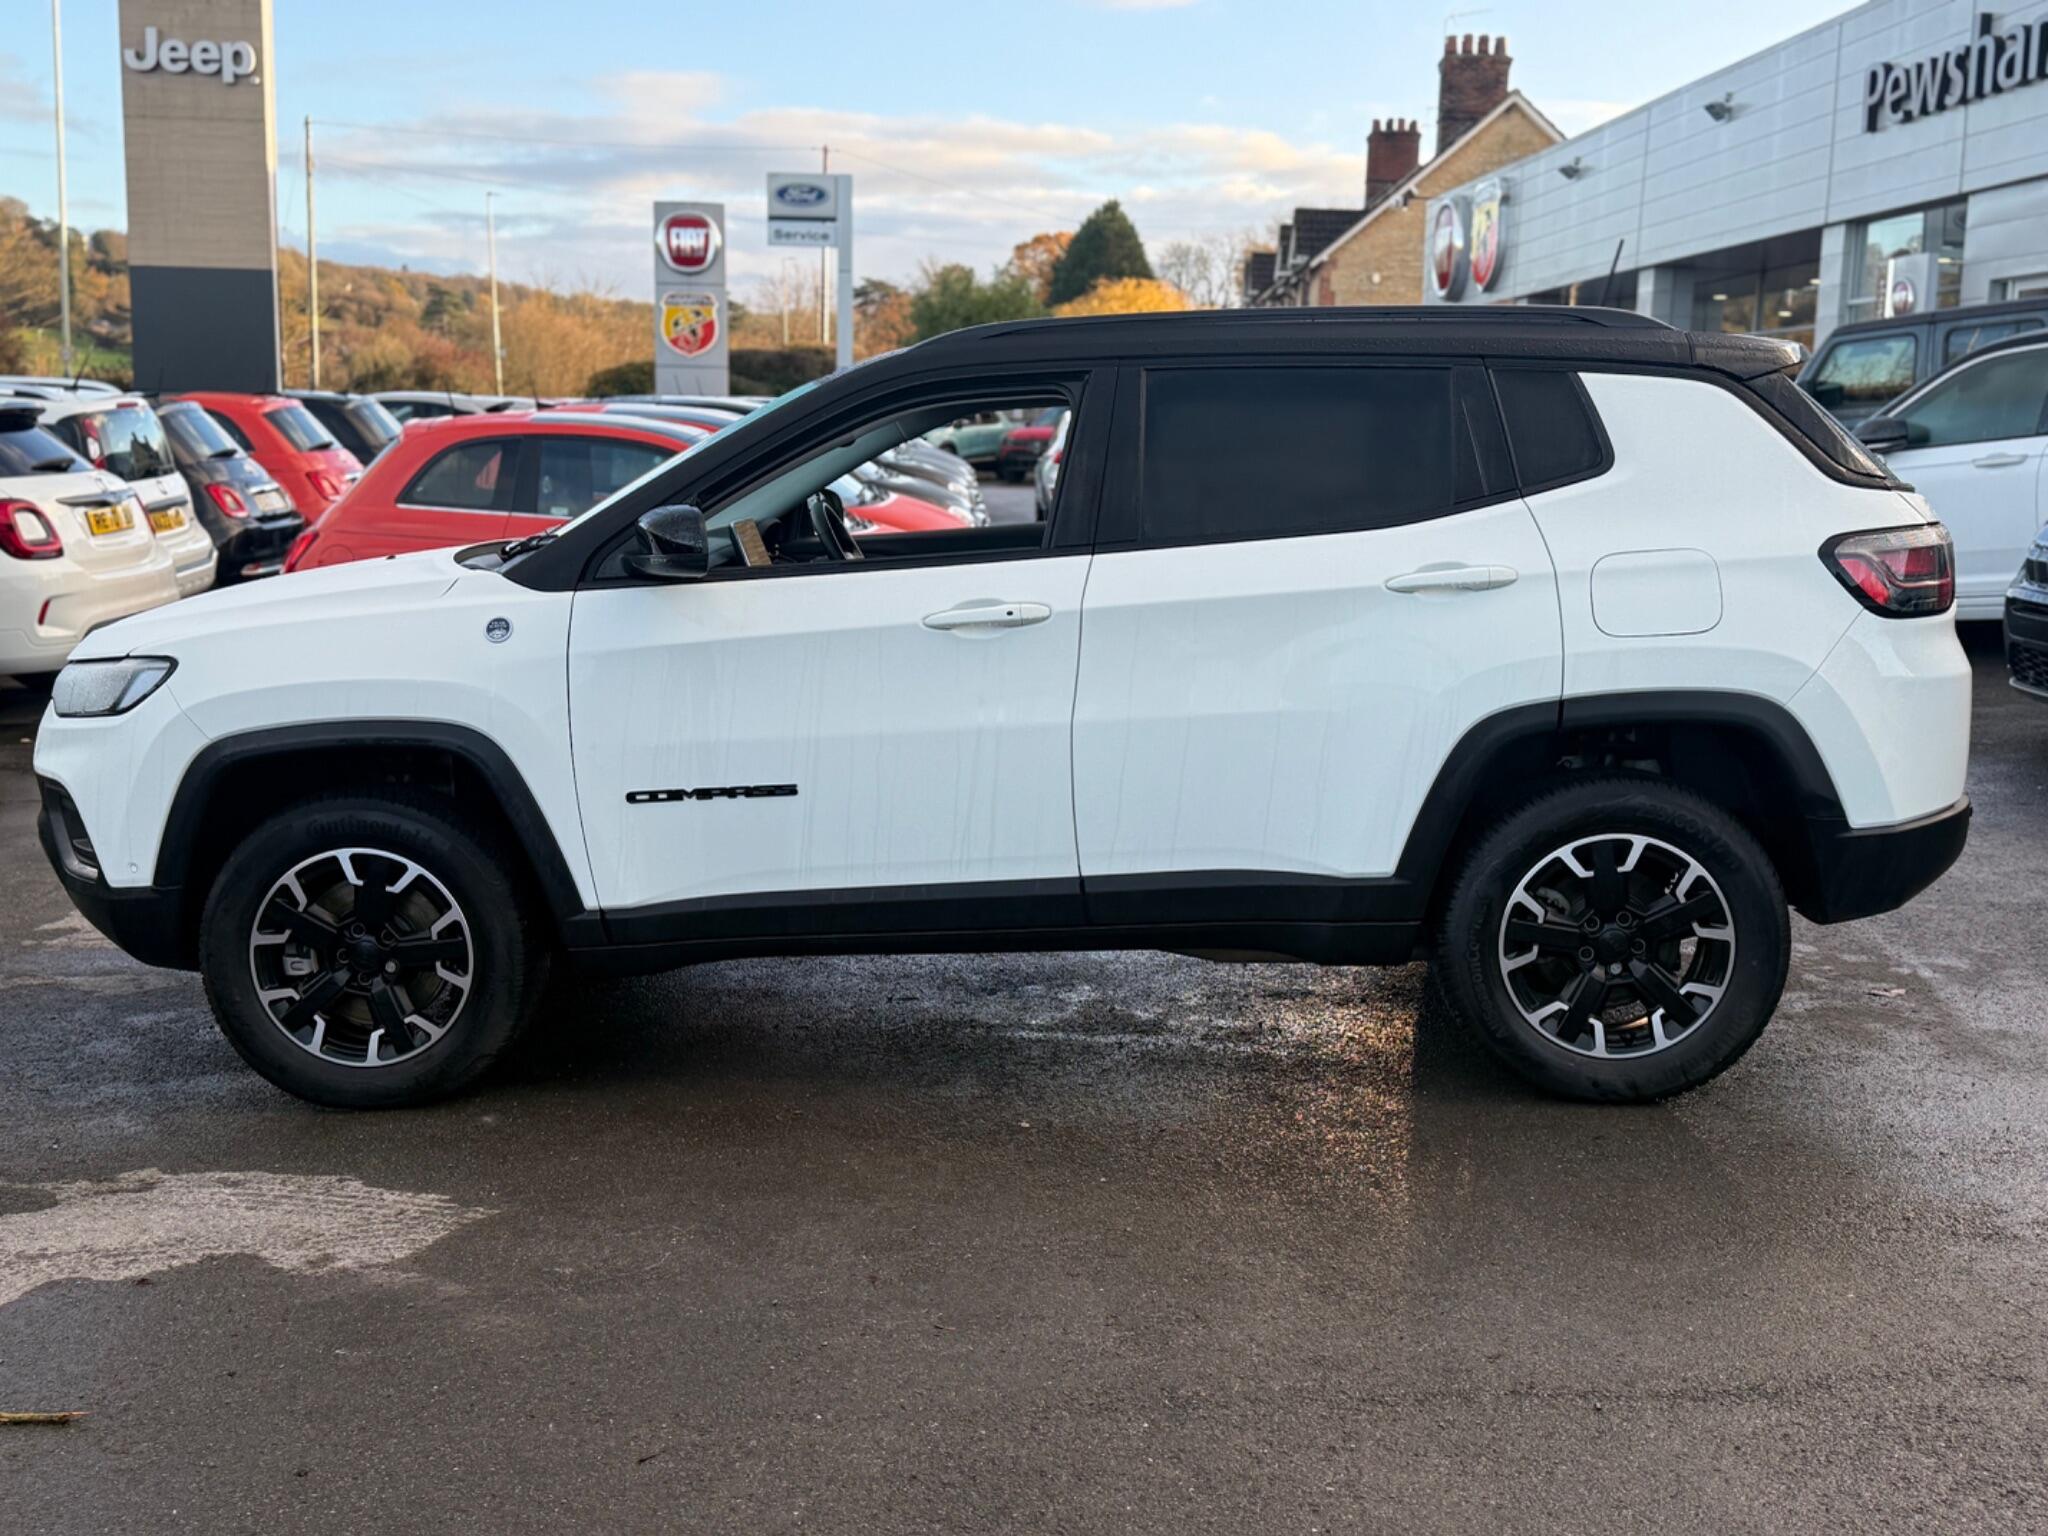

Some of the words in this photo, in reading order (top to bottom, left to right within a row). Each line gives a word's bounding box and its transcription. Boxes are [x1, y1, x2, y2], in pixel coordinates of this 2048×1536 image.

[124, 26, 257, 84] Jeep
[774, 229, 830, 241] Service
[626, 785, 798, 804] COMPASS
